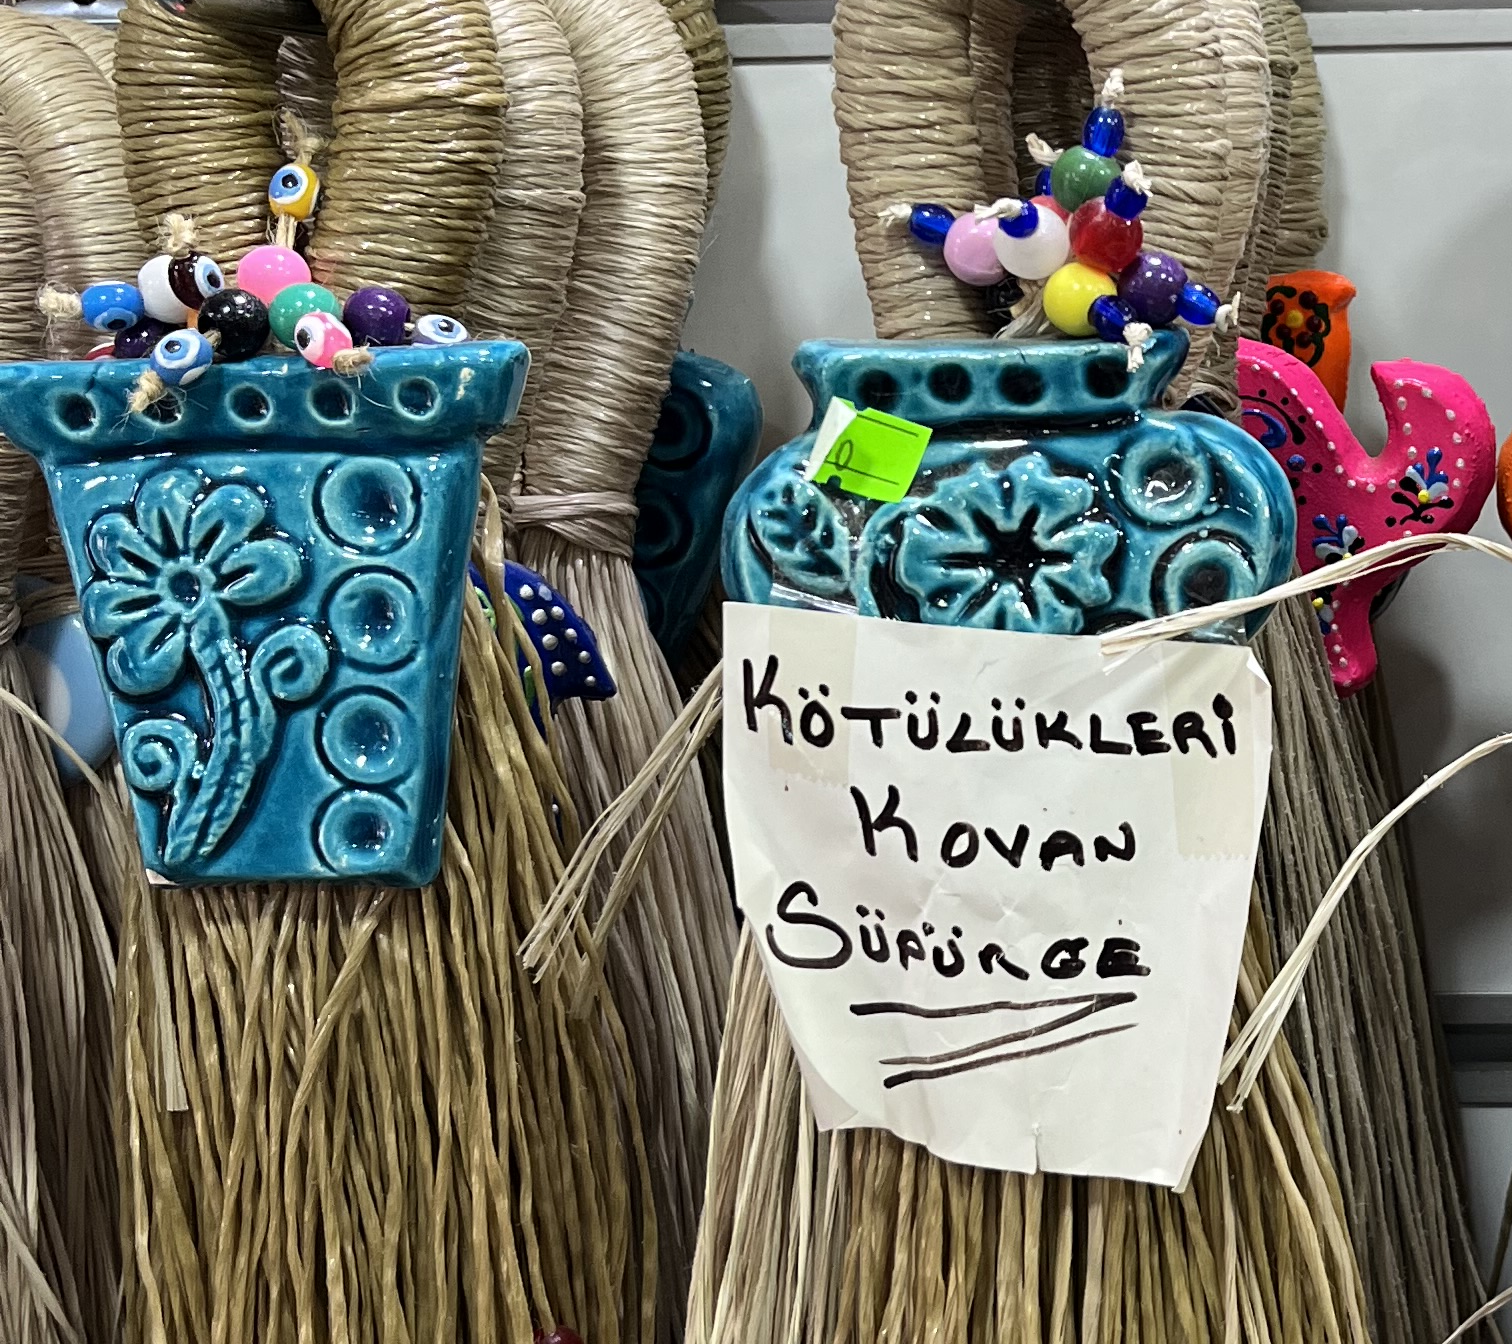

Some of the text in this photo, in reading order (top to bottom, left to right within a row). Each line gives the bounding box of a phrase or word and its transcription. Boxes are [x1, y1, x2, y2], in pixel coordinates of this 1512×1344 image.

[742, 654, 1238, 759] KÖTÜLÜKLERİ
[849, 784, 1137, 872] KOVAN
[765, 880, 1152, 981] SÜPÜRGE
